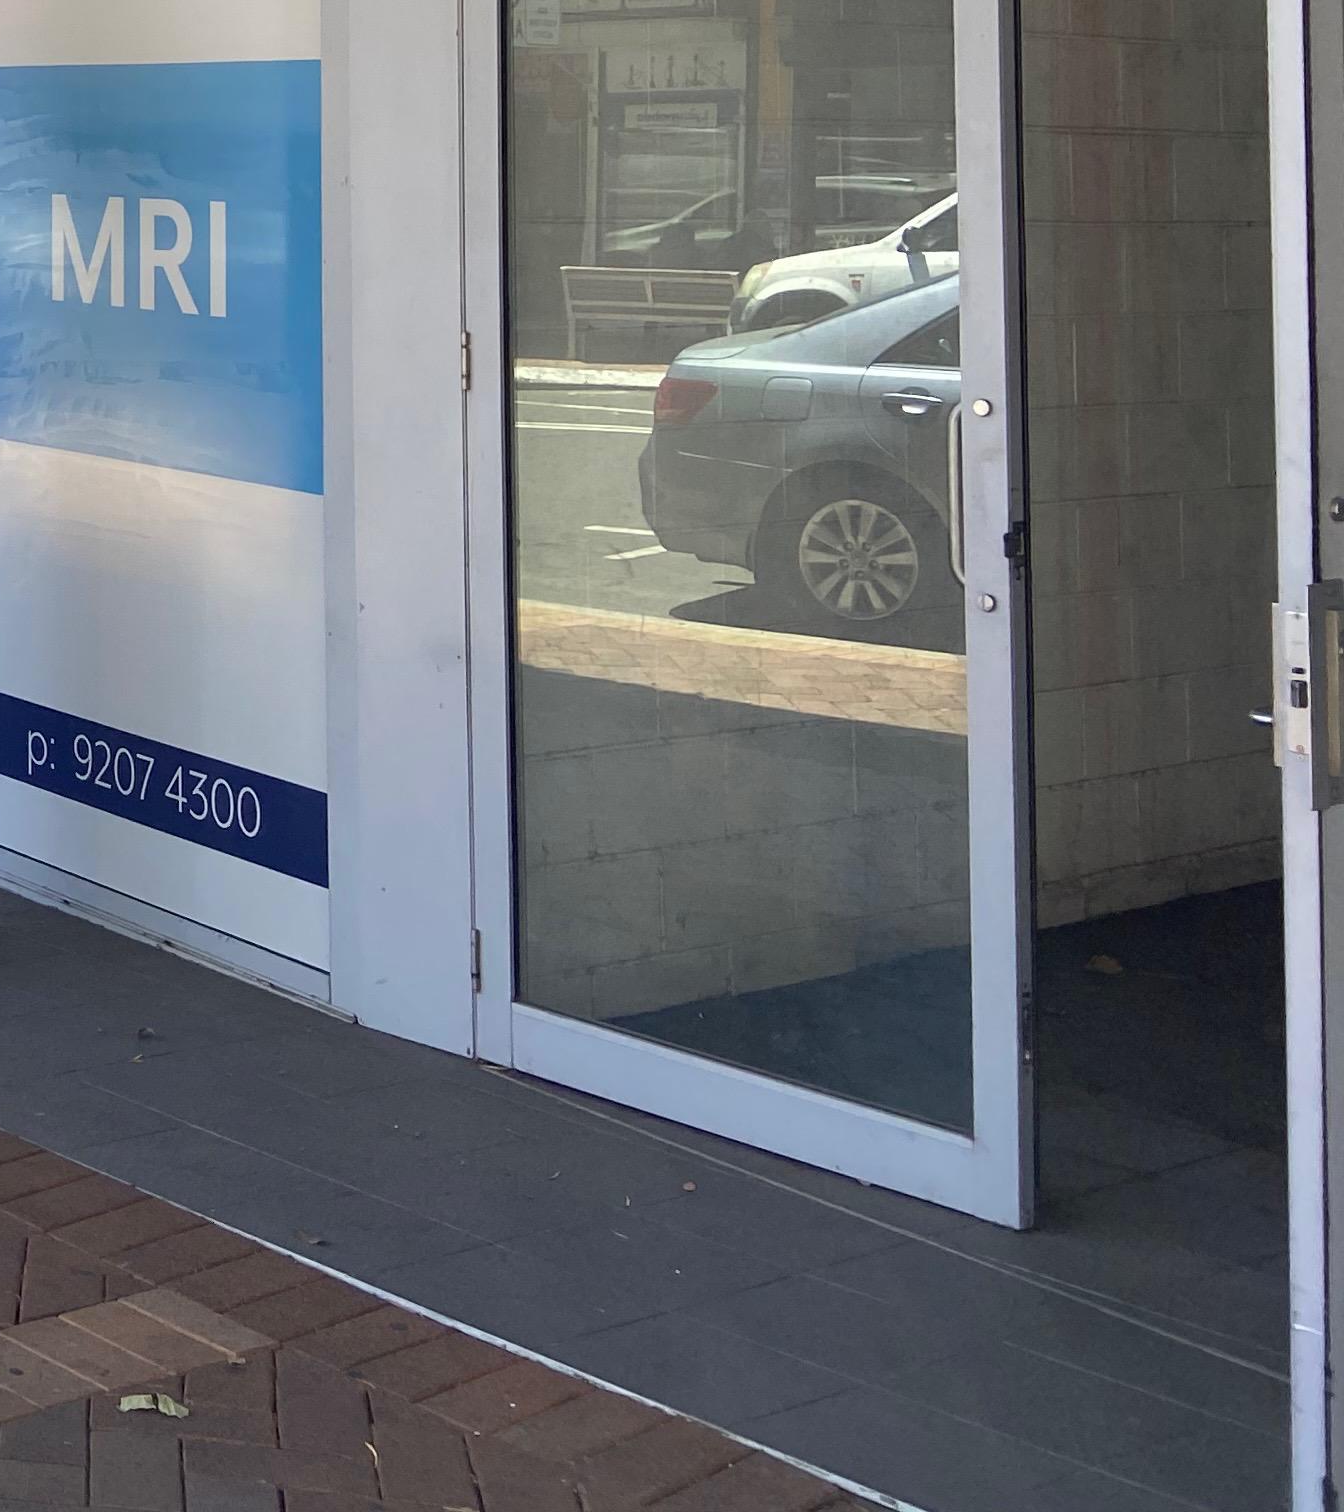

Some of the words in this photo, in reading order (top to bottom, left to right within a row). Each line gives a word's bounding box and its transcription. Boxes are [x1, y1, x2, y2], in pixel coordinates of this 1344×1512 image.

[50, 193, 227, 318] MRI
[26, 726, 56, 776] p:
[73, 733, 154, 799] 9207
[165, 764, 261, 838] 4300
